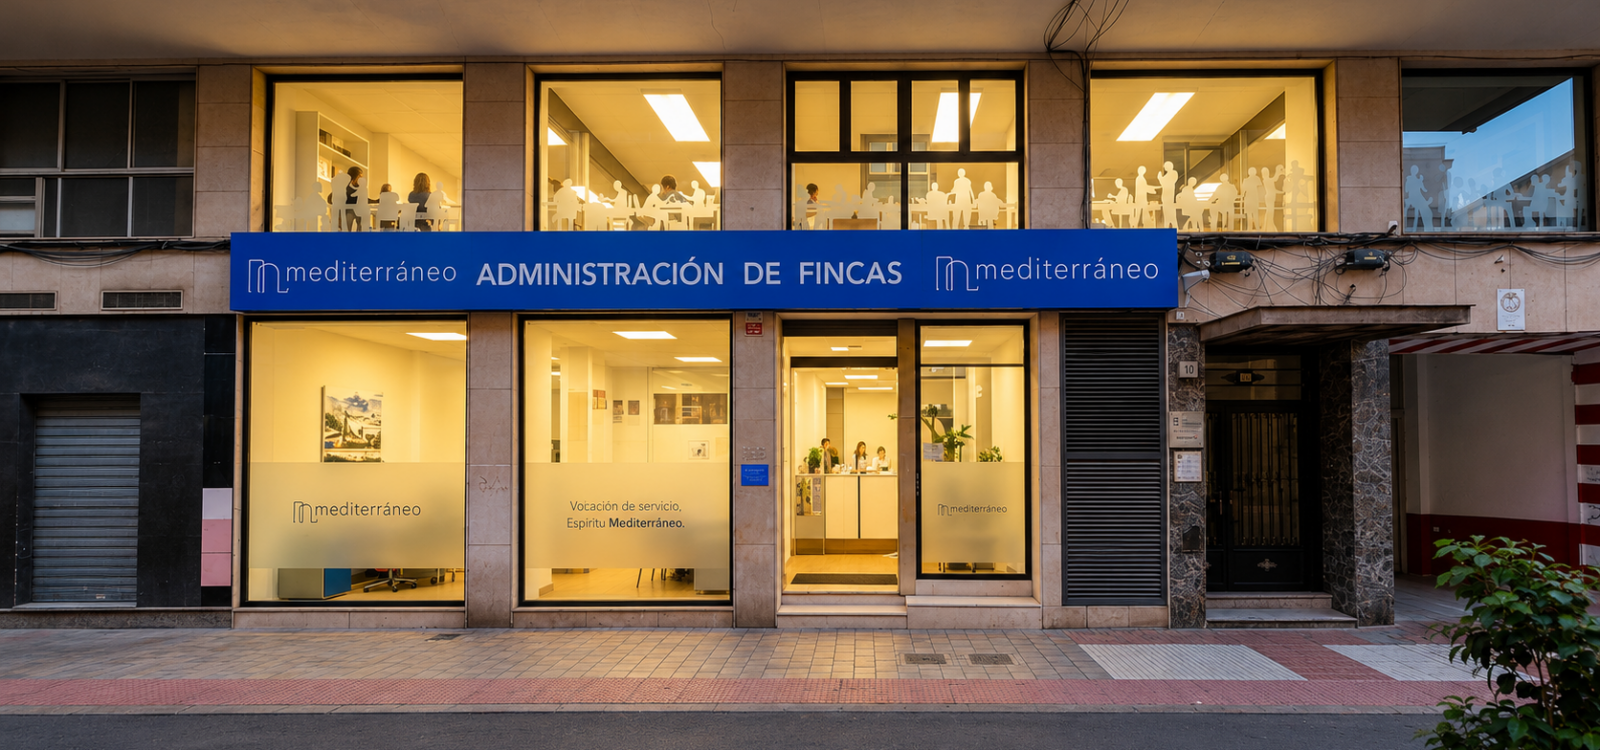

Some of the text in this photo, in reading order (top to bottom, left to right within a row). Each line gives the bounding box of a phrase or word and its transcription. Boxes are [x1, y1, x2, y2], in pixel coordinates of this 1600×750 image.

[286, 260, 457, 283] mediterráneo
[476, 257, 903, 286] ADMINISTRACIÓN DE FINCAS
[975, 256, 1159, 280] mediterráneo
[1184, 364, 1195, 375] 10
[315, 501, 421, 516] mediterráneo
[569, 500, 682, 512] Vocación de servicio,
[950, 504, 1008, 513] mediterráneo
[608, 517, 685, 528] Mediterráneo.
